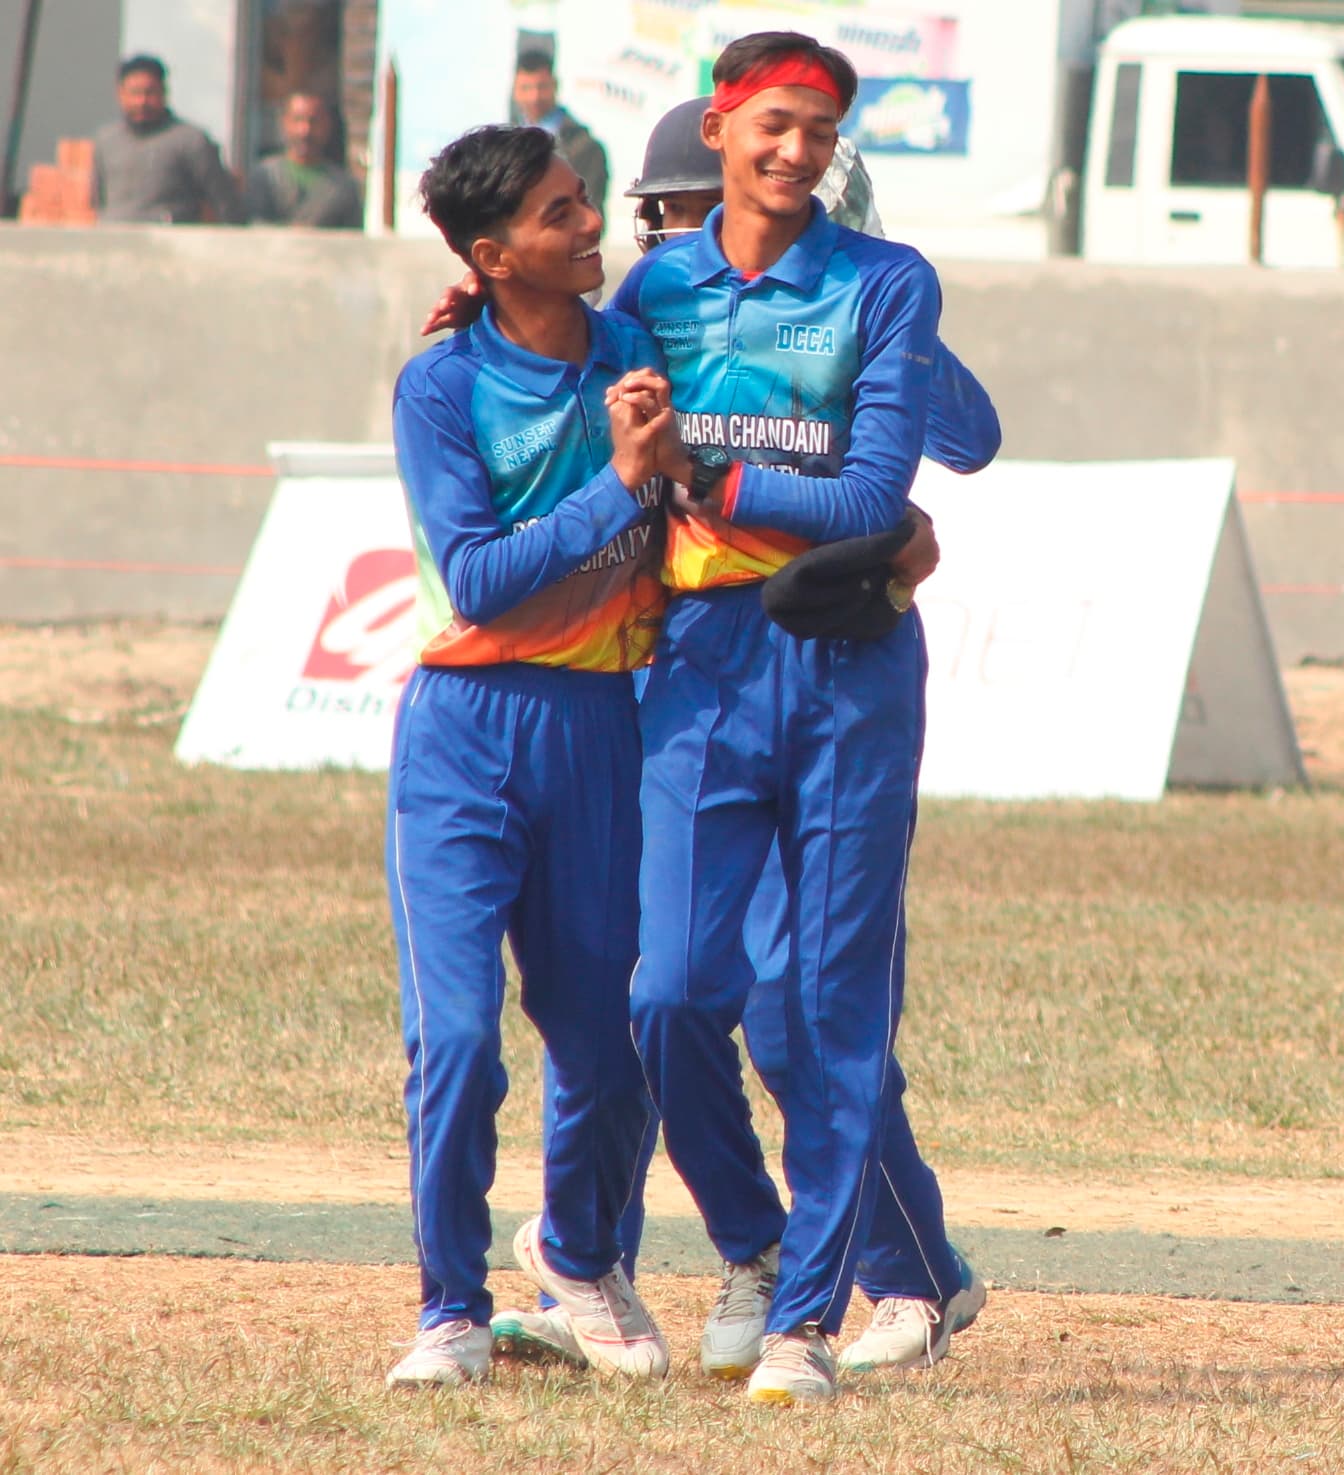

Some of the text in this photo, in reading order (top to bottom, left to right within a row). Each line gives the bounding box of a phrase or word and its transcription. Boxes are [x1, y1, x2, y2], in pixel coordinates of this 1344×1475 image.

[776, 323, 835, 356] DCCA
[492, 419, 556, 458] SUNSET
[729, 413, 830, 455] CHANDANI
[504, 437, 557, 471] NEPAL
